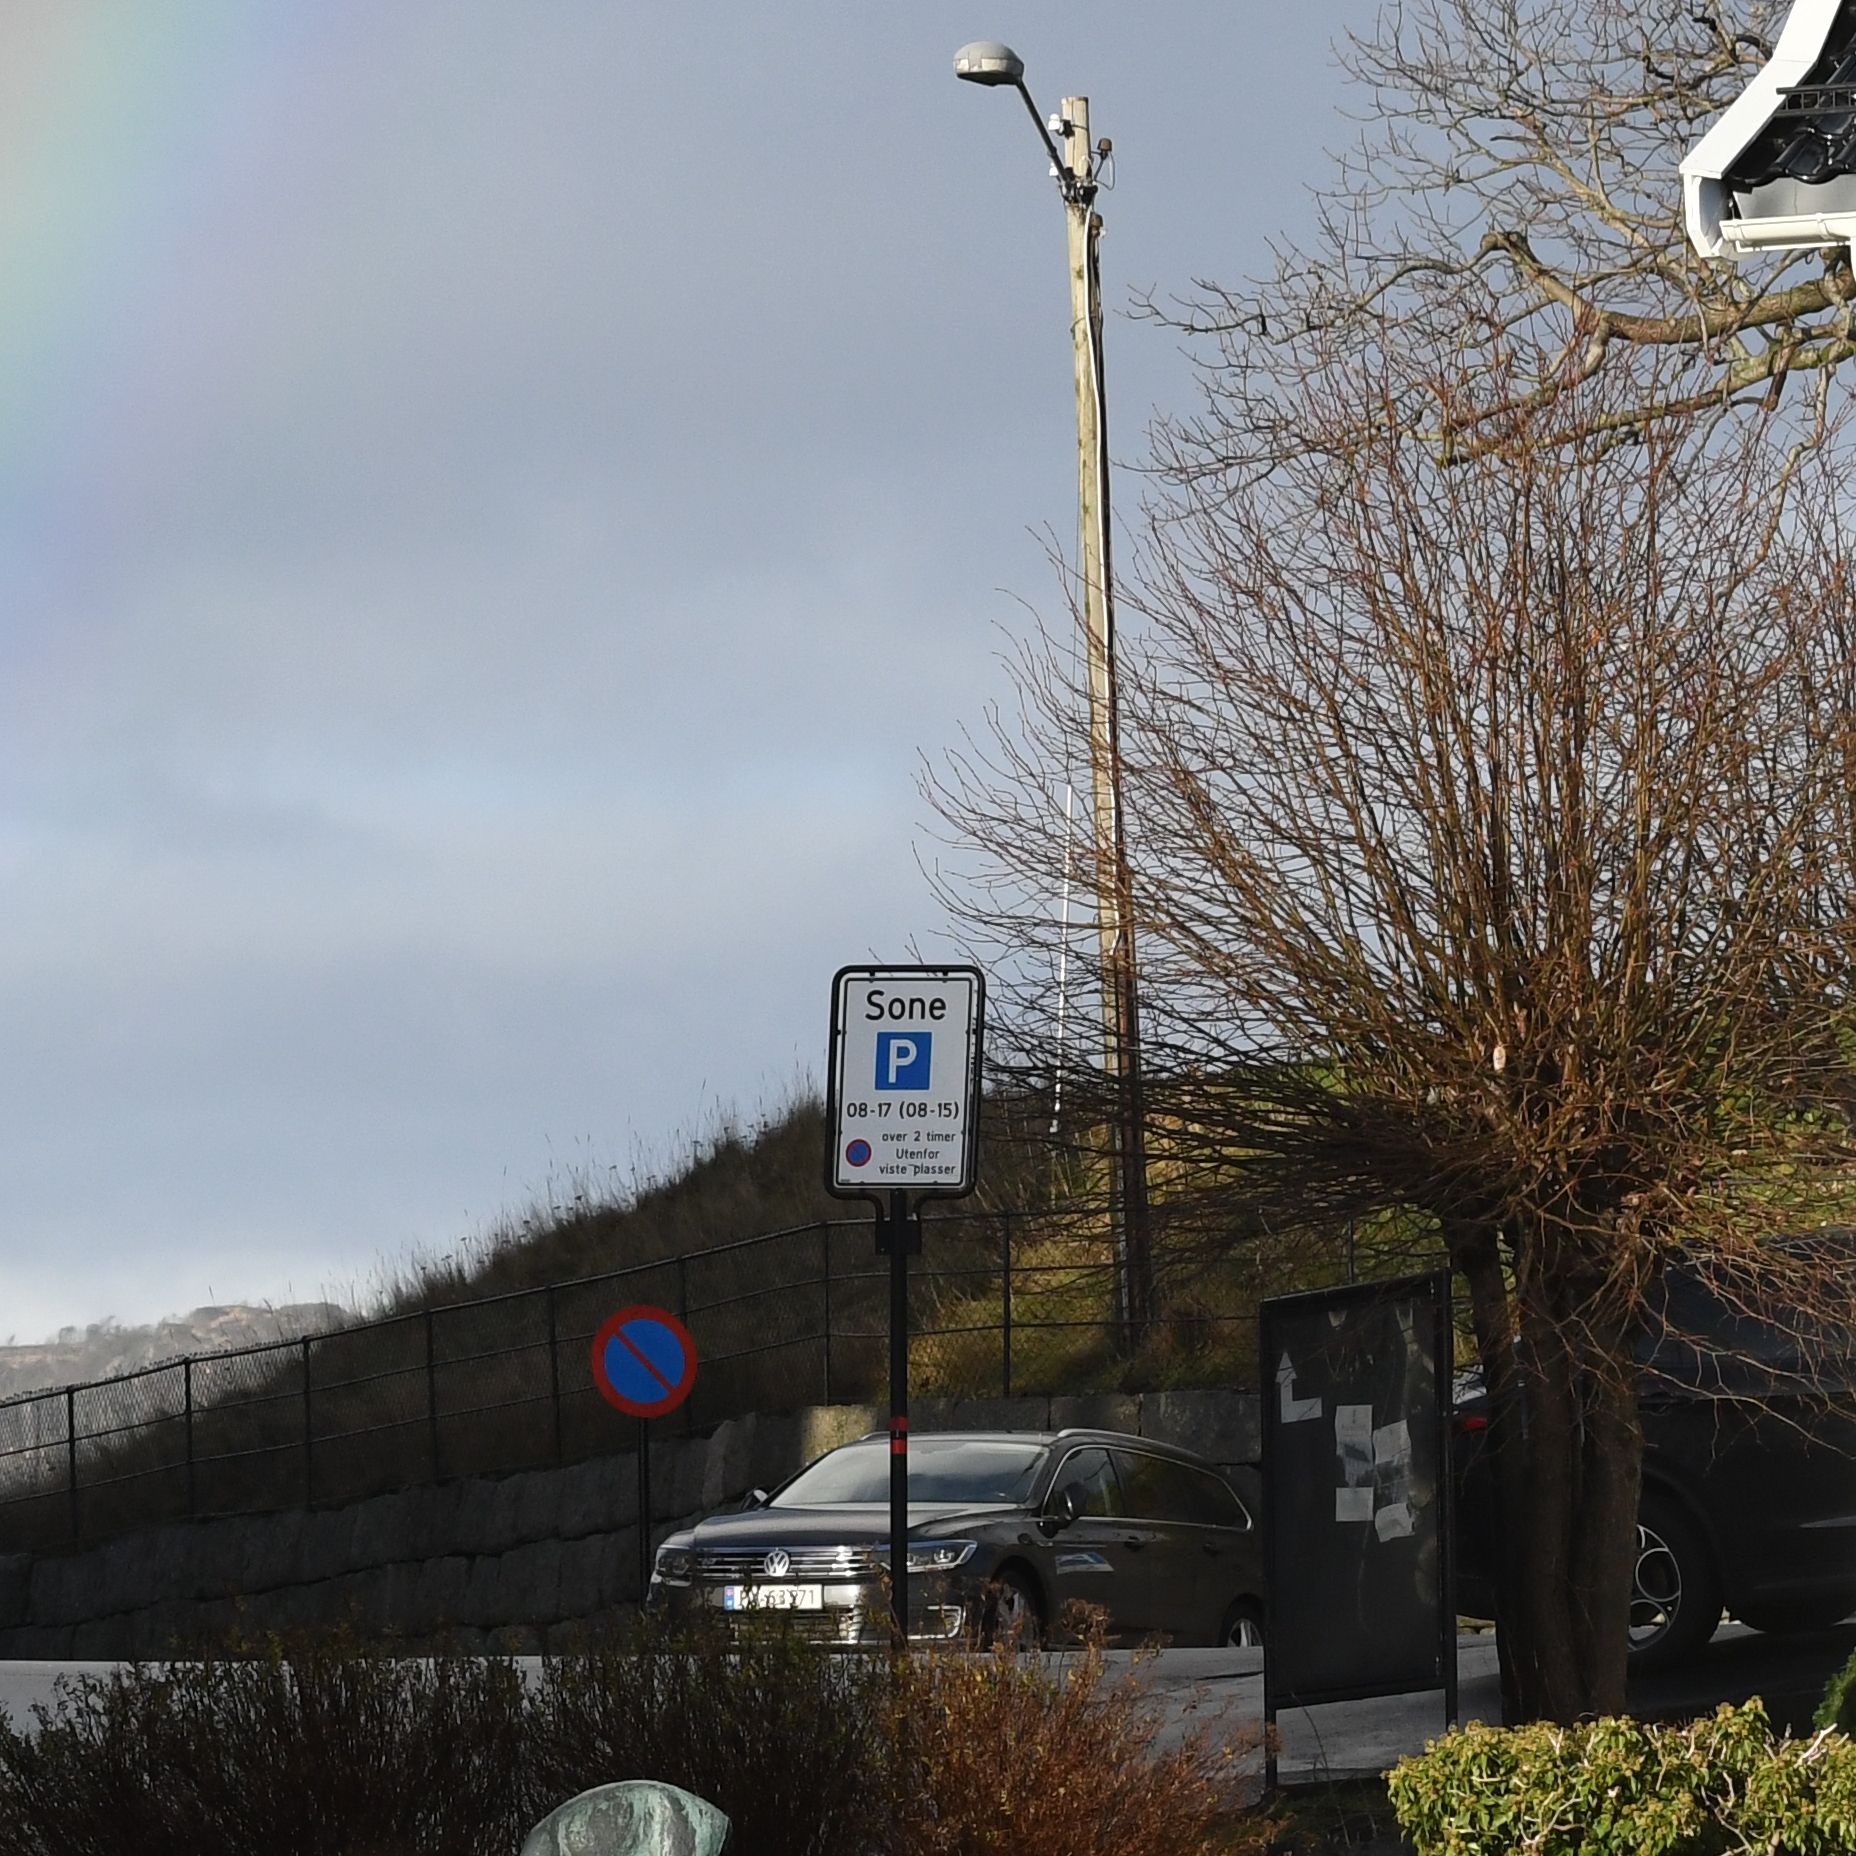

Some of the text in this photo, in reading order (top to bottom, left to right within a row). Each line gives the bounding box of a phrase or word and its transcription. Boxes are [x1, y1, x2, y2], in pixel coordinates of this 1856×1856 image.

[864, 989, 947, 1021] Sone
[888, 1038, 918, 1084] P
[846, 1100, 960, 1120] 08-17 (08-15)
[881, 1130, 957, 1142] over 2 timer
[895, 1148, 940, 1160] Utenfor
[878, 1163, 957, 1177] viste plasser
